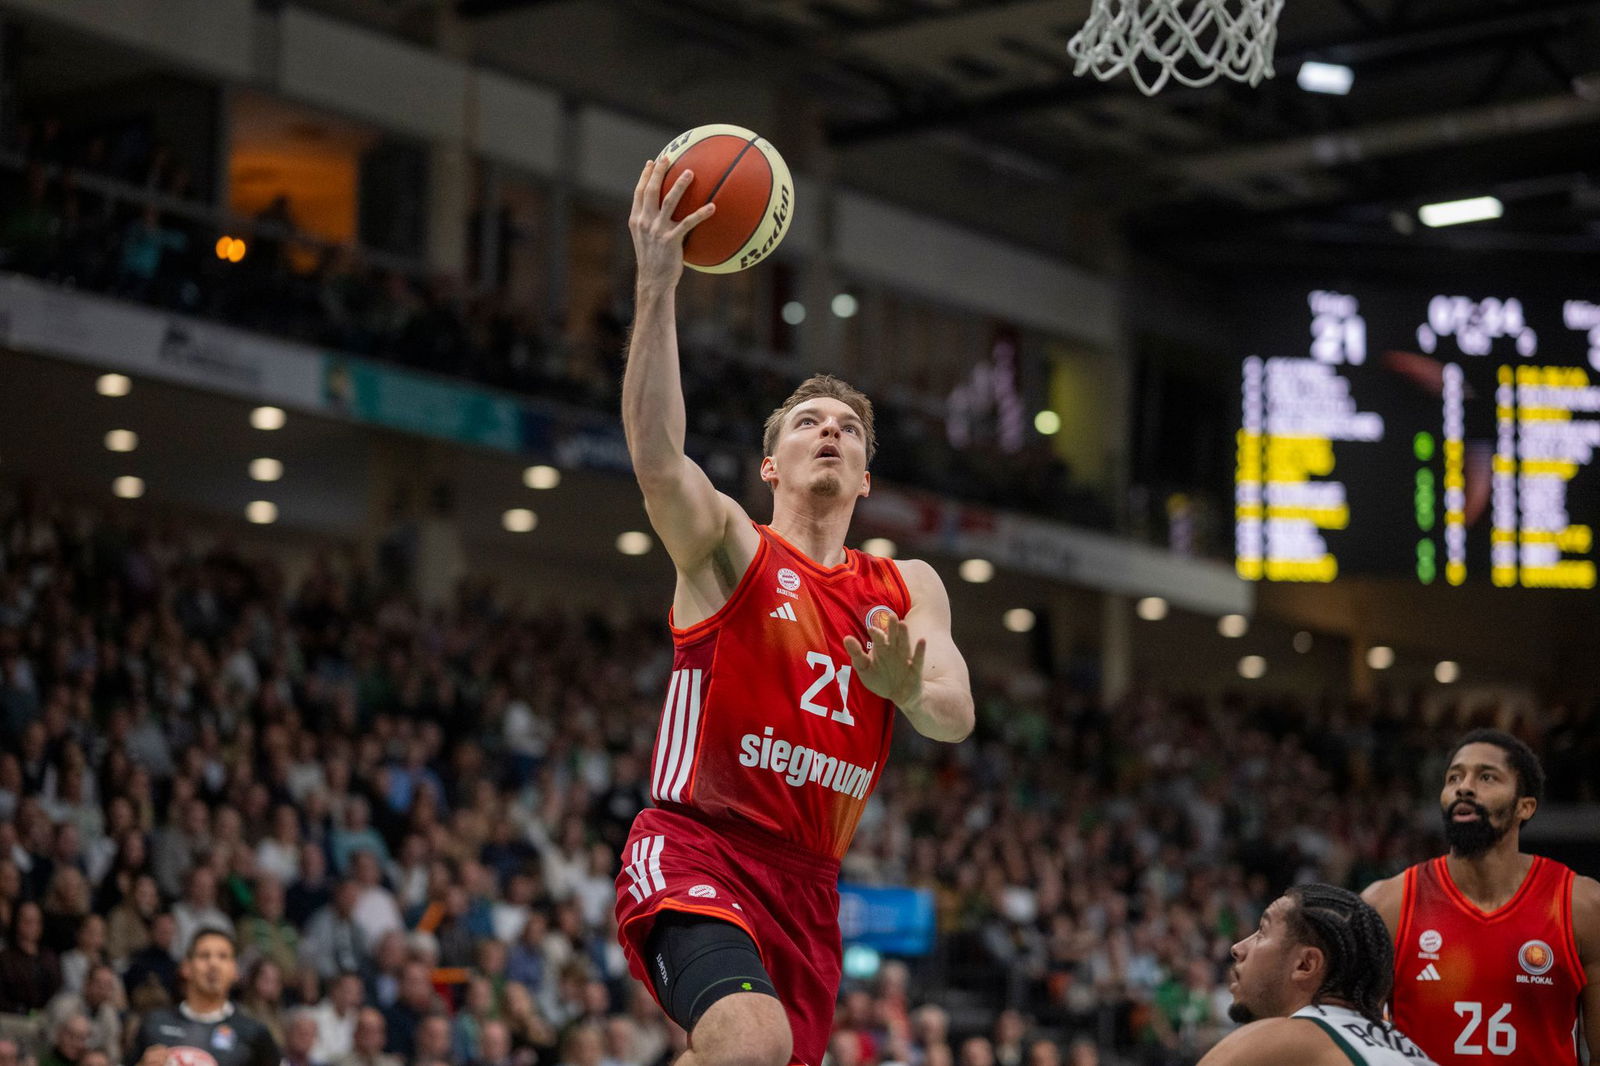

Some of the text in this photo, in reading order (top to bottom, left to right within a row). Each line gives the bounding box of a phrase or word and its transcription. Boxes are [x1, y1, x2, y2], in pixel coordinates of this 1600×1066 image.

[740, 184, 789, 268] Baden
[800, 651, 855, 727] 21
[738, 726, 877, 800] siegmund
[1516, 974, 1554, 986] BBL POKAL
[1454, 1001, 1517, 1056] 26
